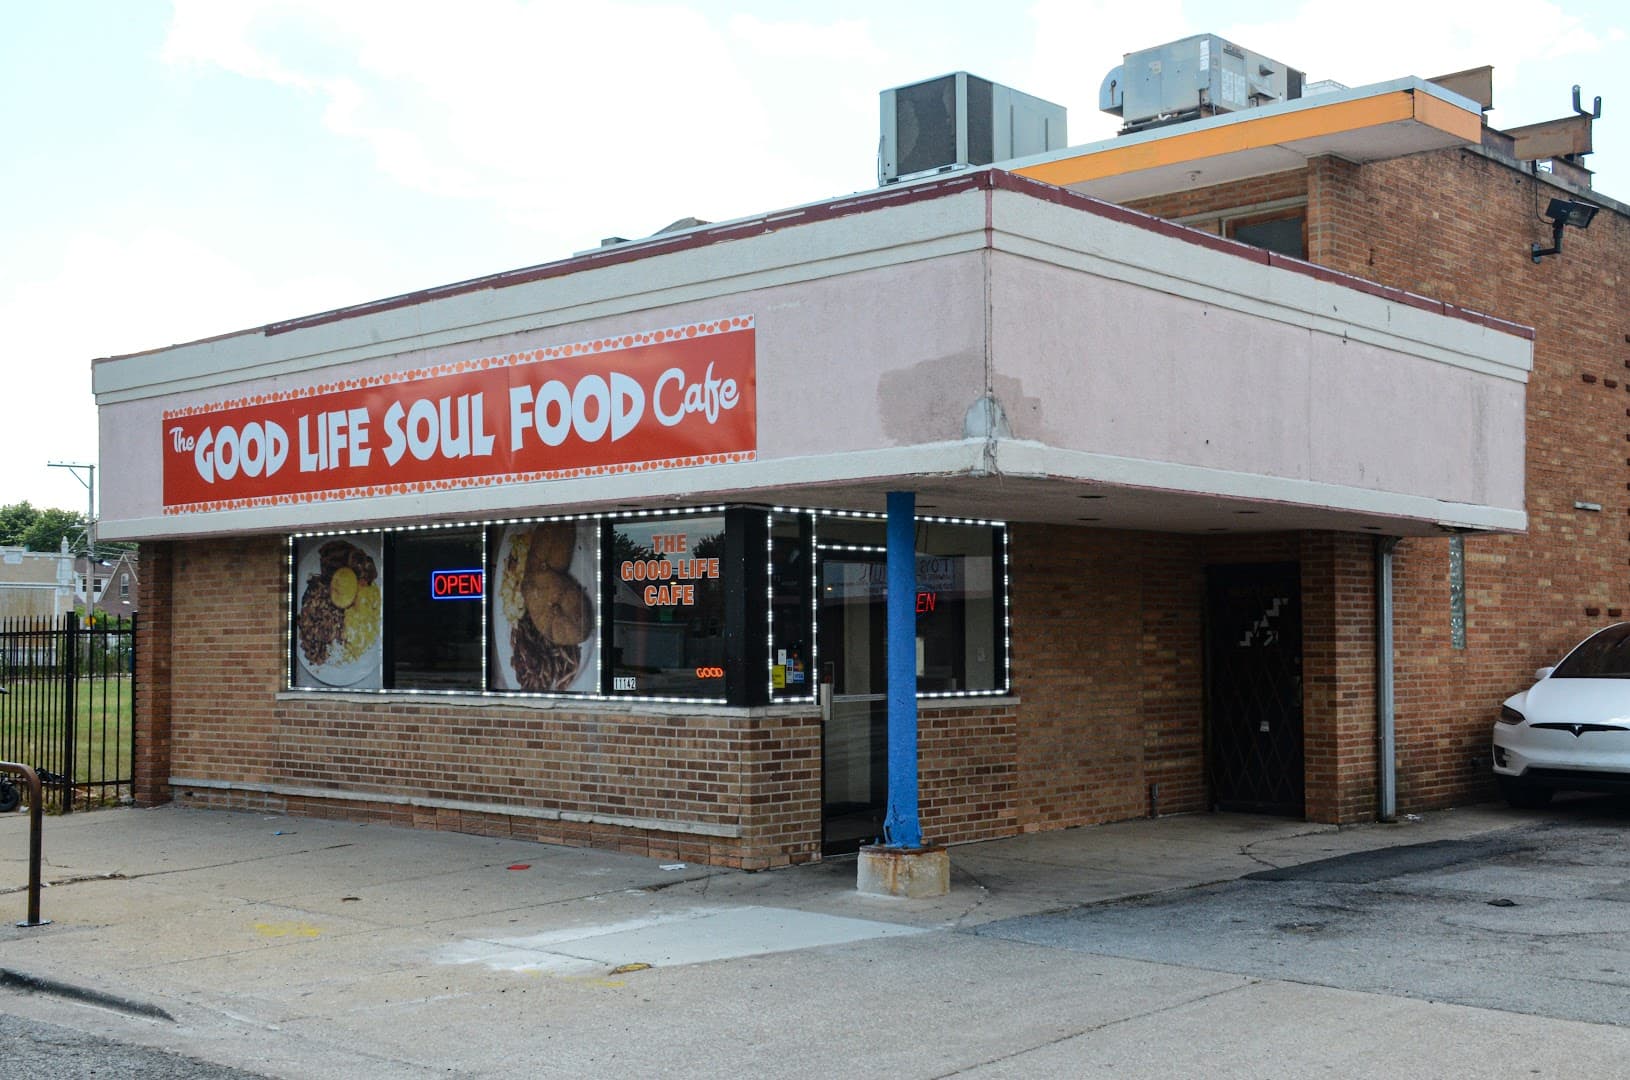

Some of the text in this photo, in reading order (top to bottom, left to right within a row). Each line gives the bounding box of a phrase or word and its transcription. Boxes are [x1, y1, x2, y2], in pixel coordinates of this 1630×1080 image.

[169, 361, 740, 484] The GOOD LIFE SOUL FOOD Cafe
[651, 533, 688, 554] THE
[621, 557, 719, 581] GOOD LIFE
[434, 574, 482, 595] OPEN
[644, 584, 695, 606] CAFE
[915, 592, 936, 613] EN
